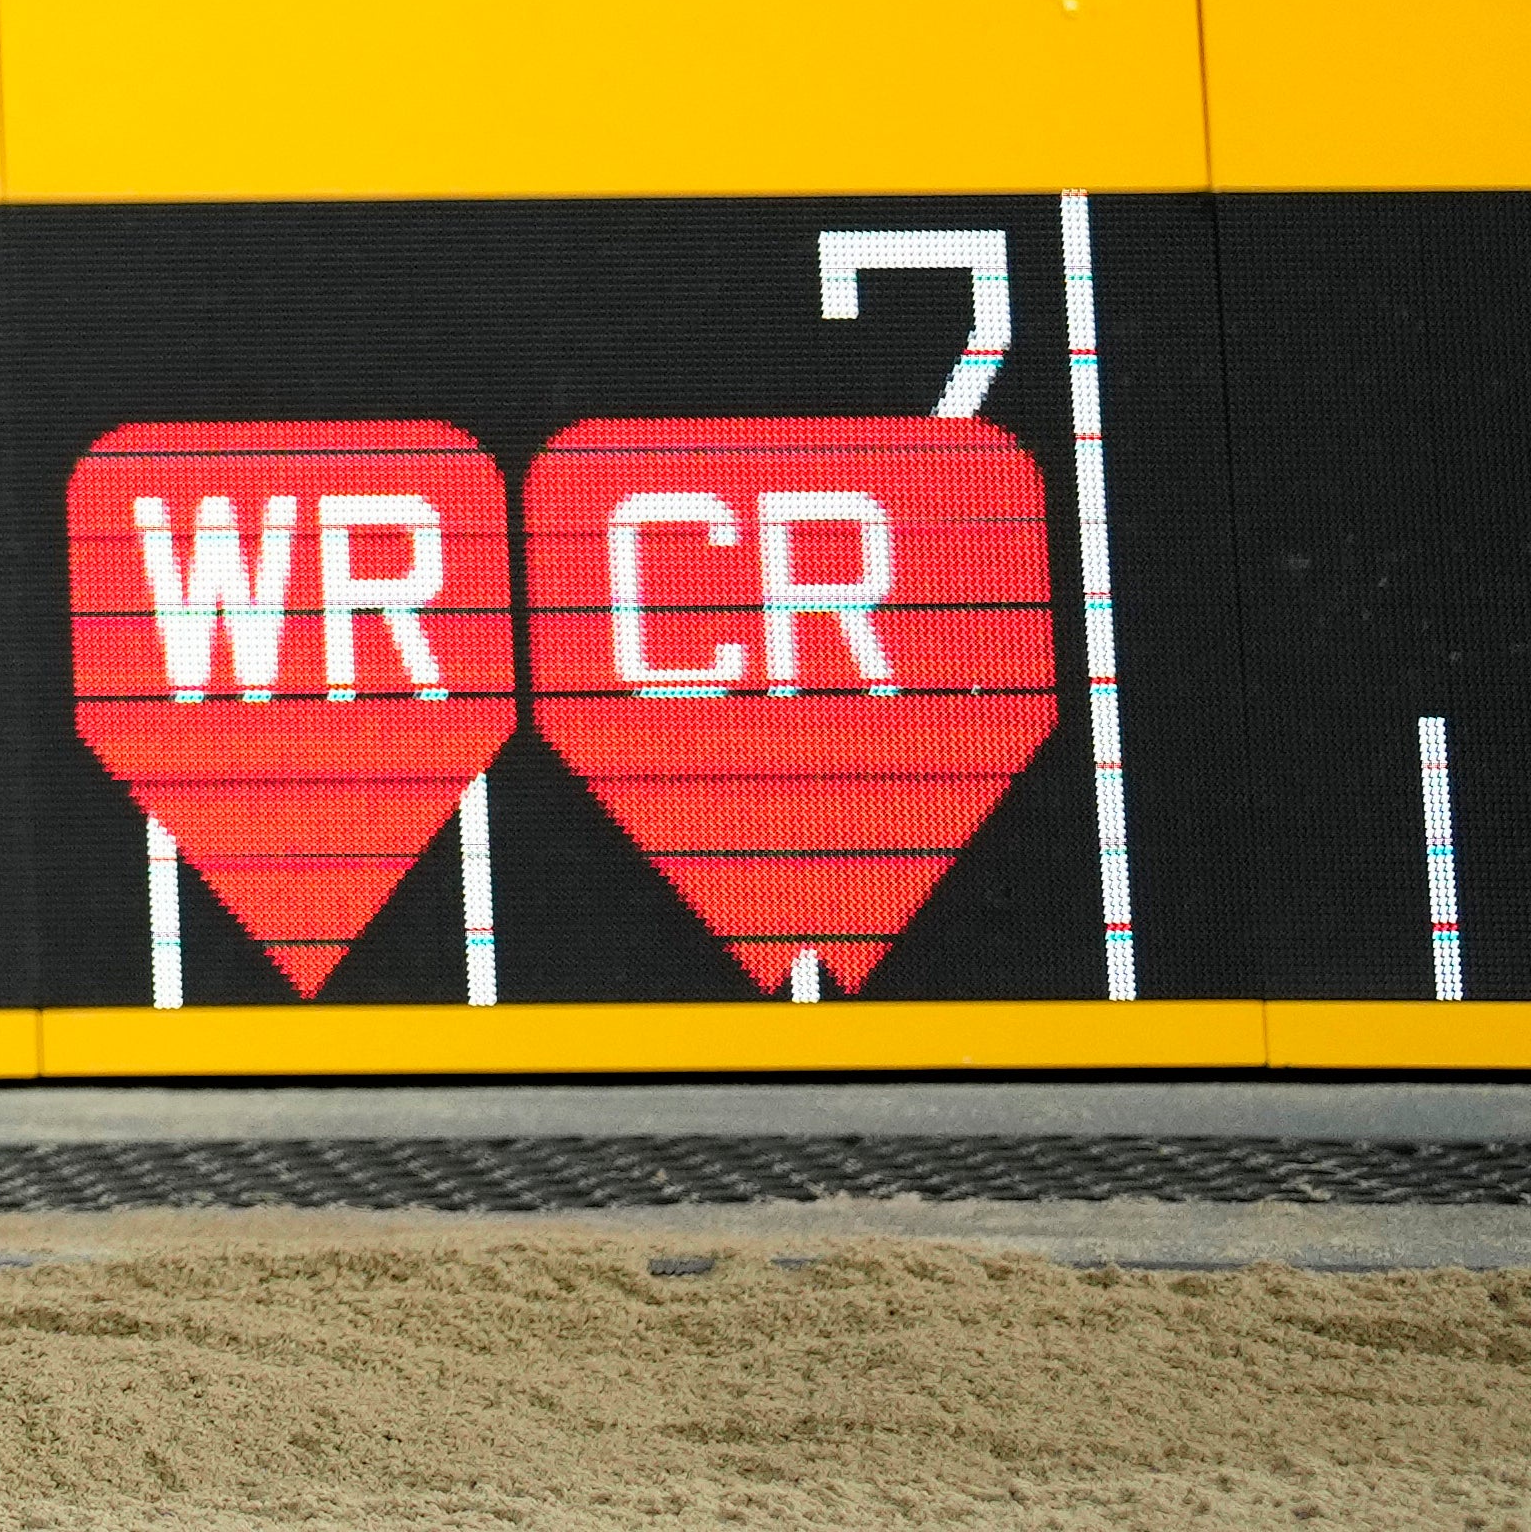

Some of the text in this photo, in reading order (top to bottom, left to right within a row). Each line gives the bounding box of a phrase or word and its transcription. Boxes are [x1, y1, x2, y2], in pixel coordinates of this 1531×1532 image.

[819, 230, 1011, 417] 7
[134, 496, 450, 703] WR
[607, 491, 900, 698] CR
